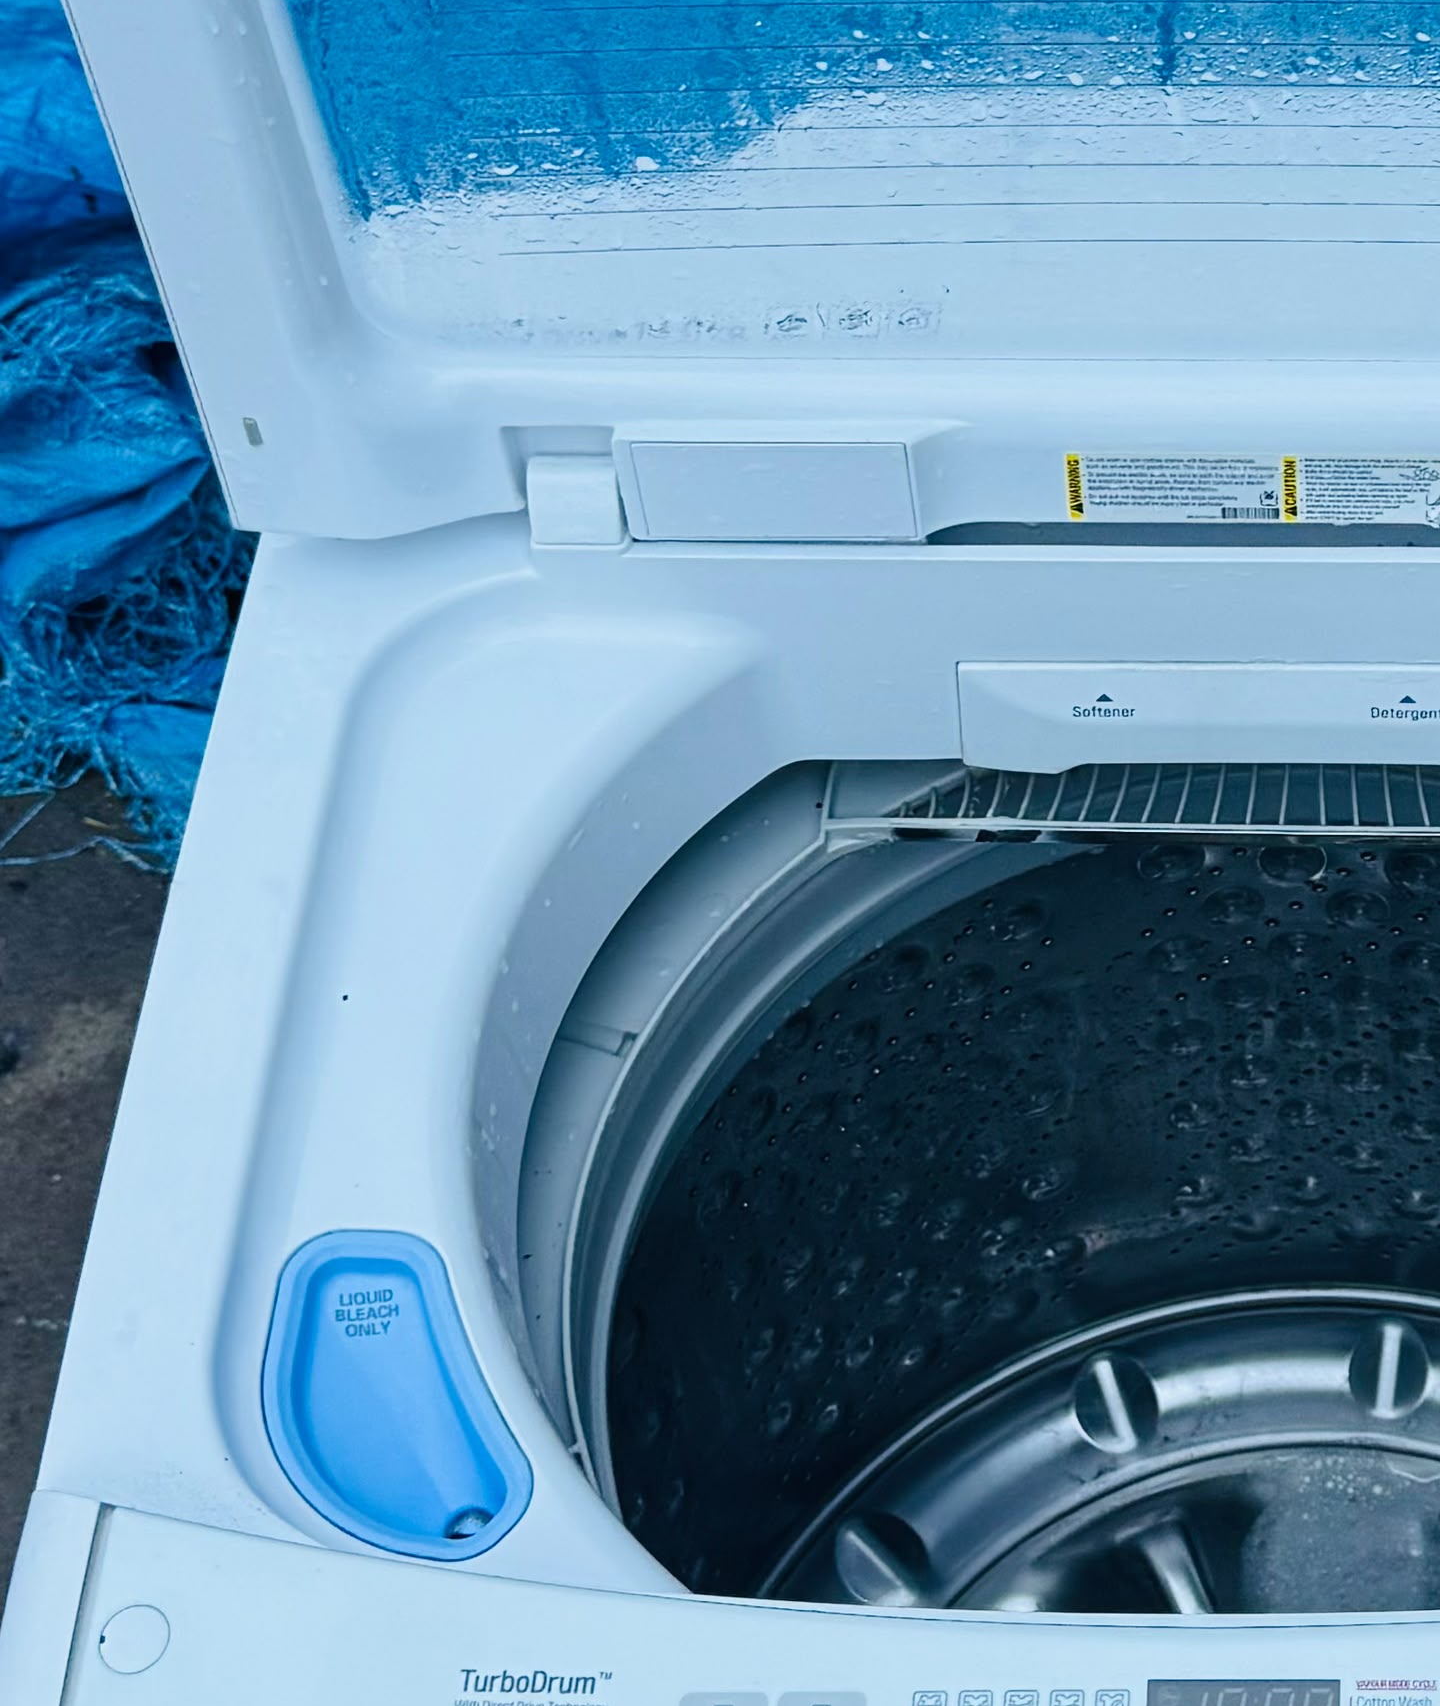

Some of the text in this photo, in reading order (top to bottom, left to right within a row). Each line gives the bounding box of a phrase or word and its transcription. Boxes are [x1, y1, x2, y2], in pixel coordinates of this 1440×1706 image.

[1068, 459, 1084, 506] WARNING
[1283, 460, 1298, 506] CAUTION
[1072, 705, 1135, 719] Softener
[339, 1288, 394, 1307] LIQUID
[335, 1305, 400, 1322] BLEACH
[345, 1320, 391, 1338] ONLY
